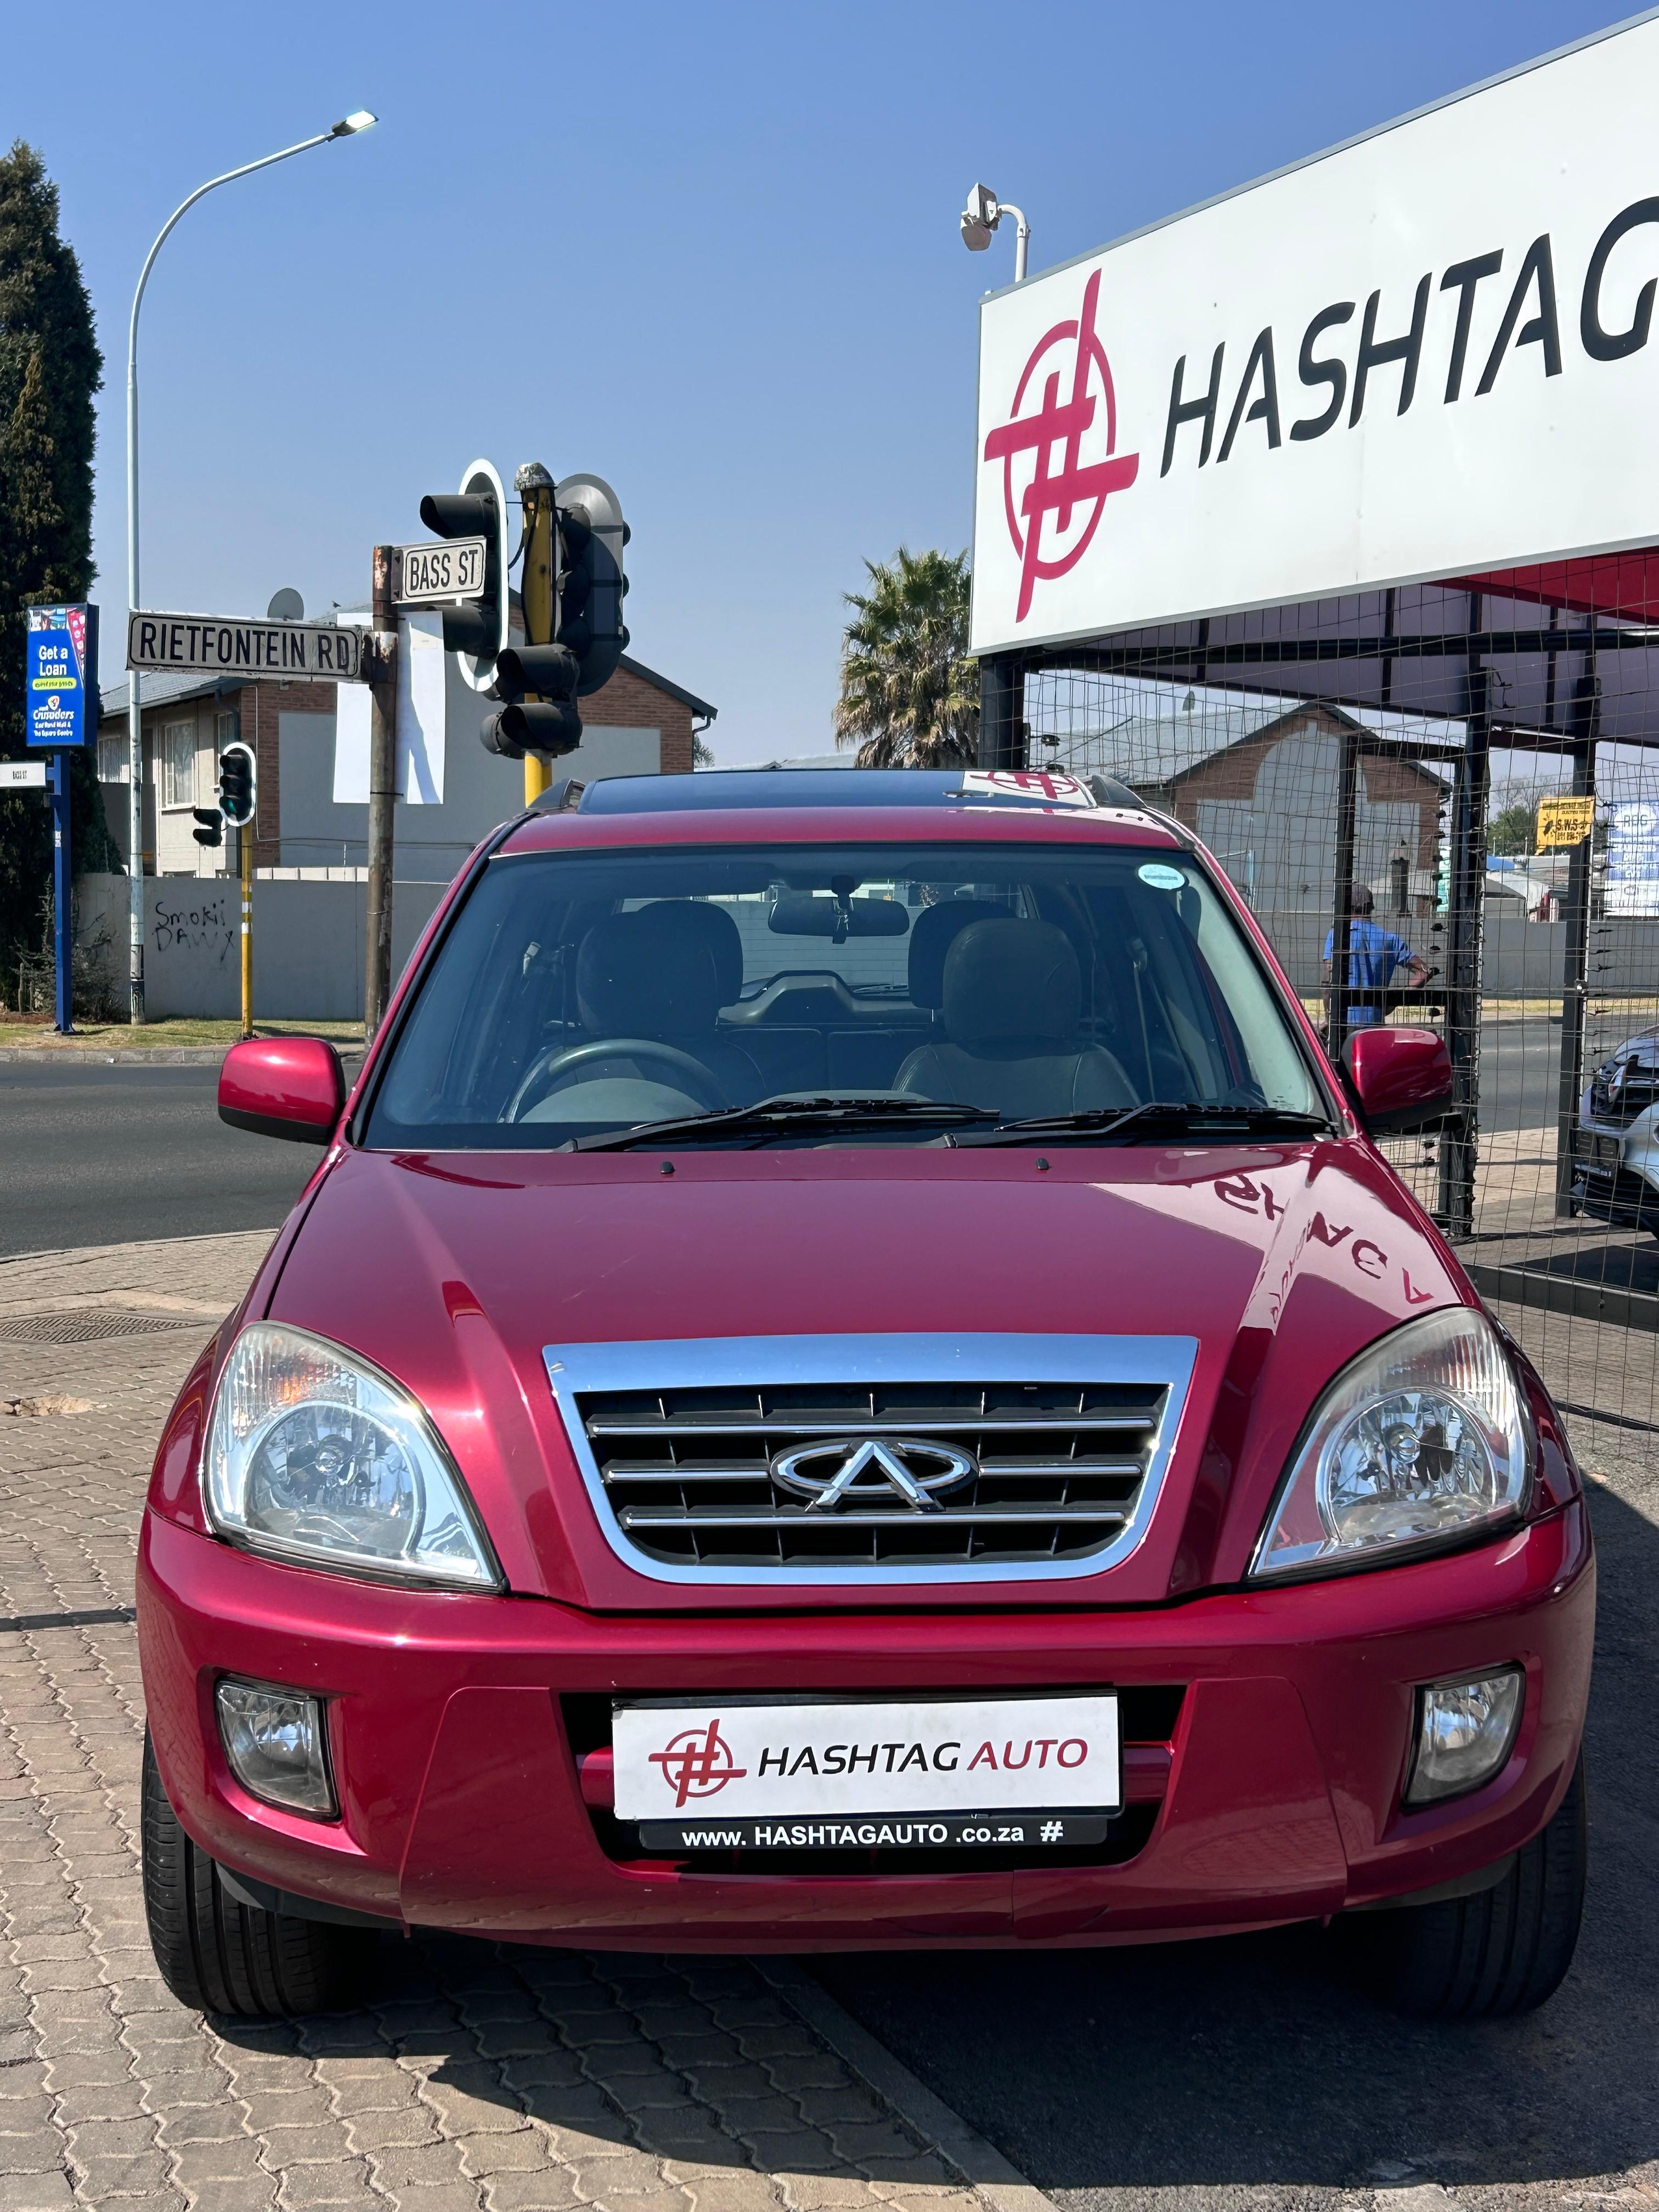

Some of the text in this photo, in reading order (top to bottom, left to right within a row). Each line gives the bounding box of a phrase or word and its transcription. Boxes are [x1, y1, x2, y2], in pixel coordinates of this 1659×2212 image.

[1160, 196, 1659, 478] HASHTAG
[410, 549, 478, 591] BASS ST
[39, 645, 68, 660] Get a
[140, 622, 350, 670] RIETFONTEIN RD
[40, 662, 67, 676] Loan
[758, 1738, 1088, 1777] HASHTAG AUTO
[681, 1831, 747, 1847] www.
[754, 1824, 949, 1846] HASHTAGAUTO
[956, 1826, 1025, 1843] .co.za
